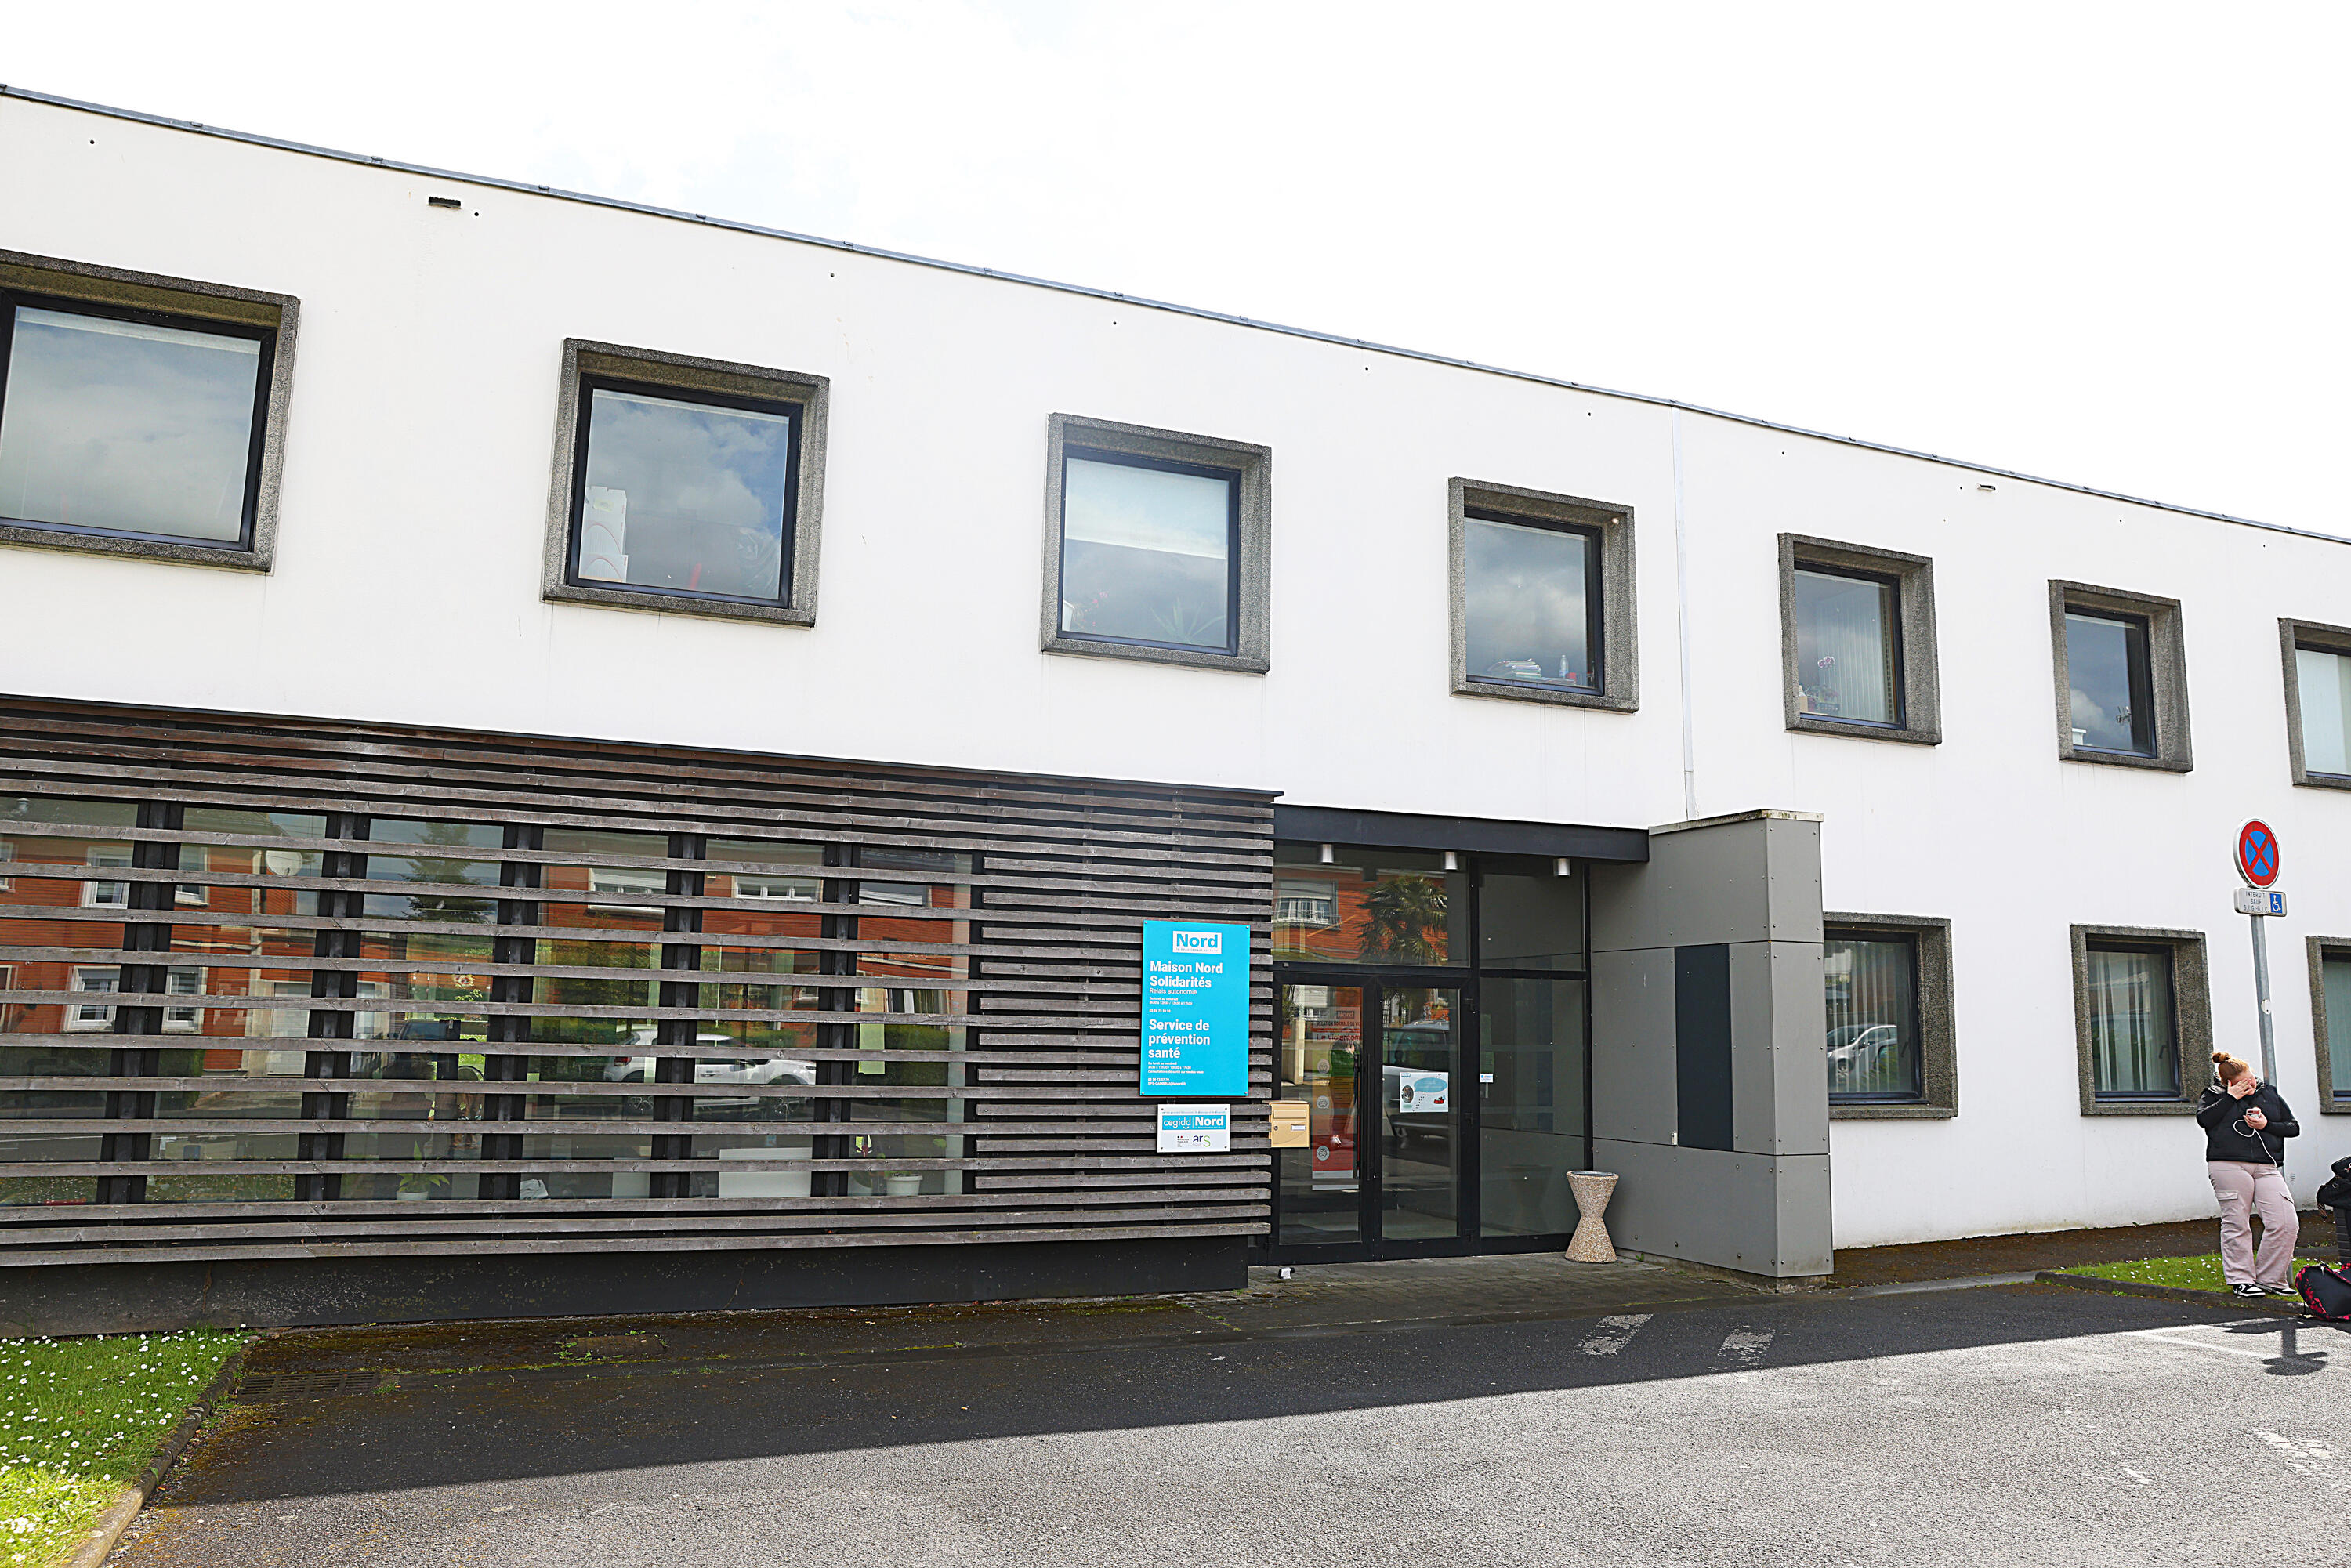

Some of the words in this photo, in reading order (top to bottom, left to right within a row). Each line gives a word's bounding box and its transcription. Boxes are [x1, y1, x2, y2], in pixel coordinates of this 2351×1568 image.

[1176, 933, 1219, 948] Nord
[1150, 960, 1193, 973] Maison
[1195, 961, 1223, 974] Nord
[1150, 975, 1212, 988] Solidarités
[1148, 1019, 1193, 1030] Service
[1195, 1019, 1210, 1031] de
[1148, 1032, 1211, 1047] prévention
[1148, 1047, 1181, 1059] santé
[1164, 1116, 1191, 1128] cegidd
[1195, 1115, 1224, 1126] Nord
